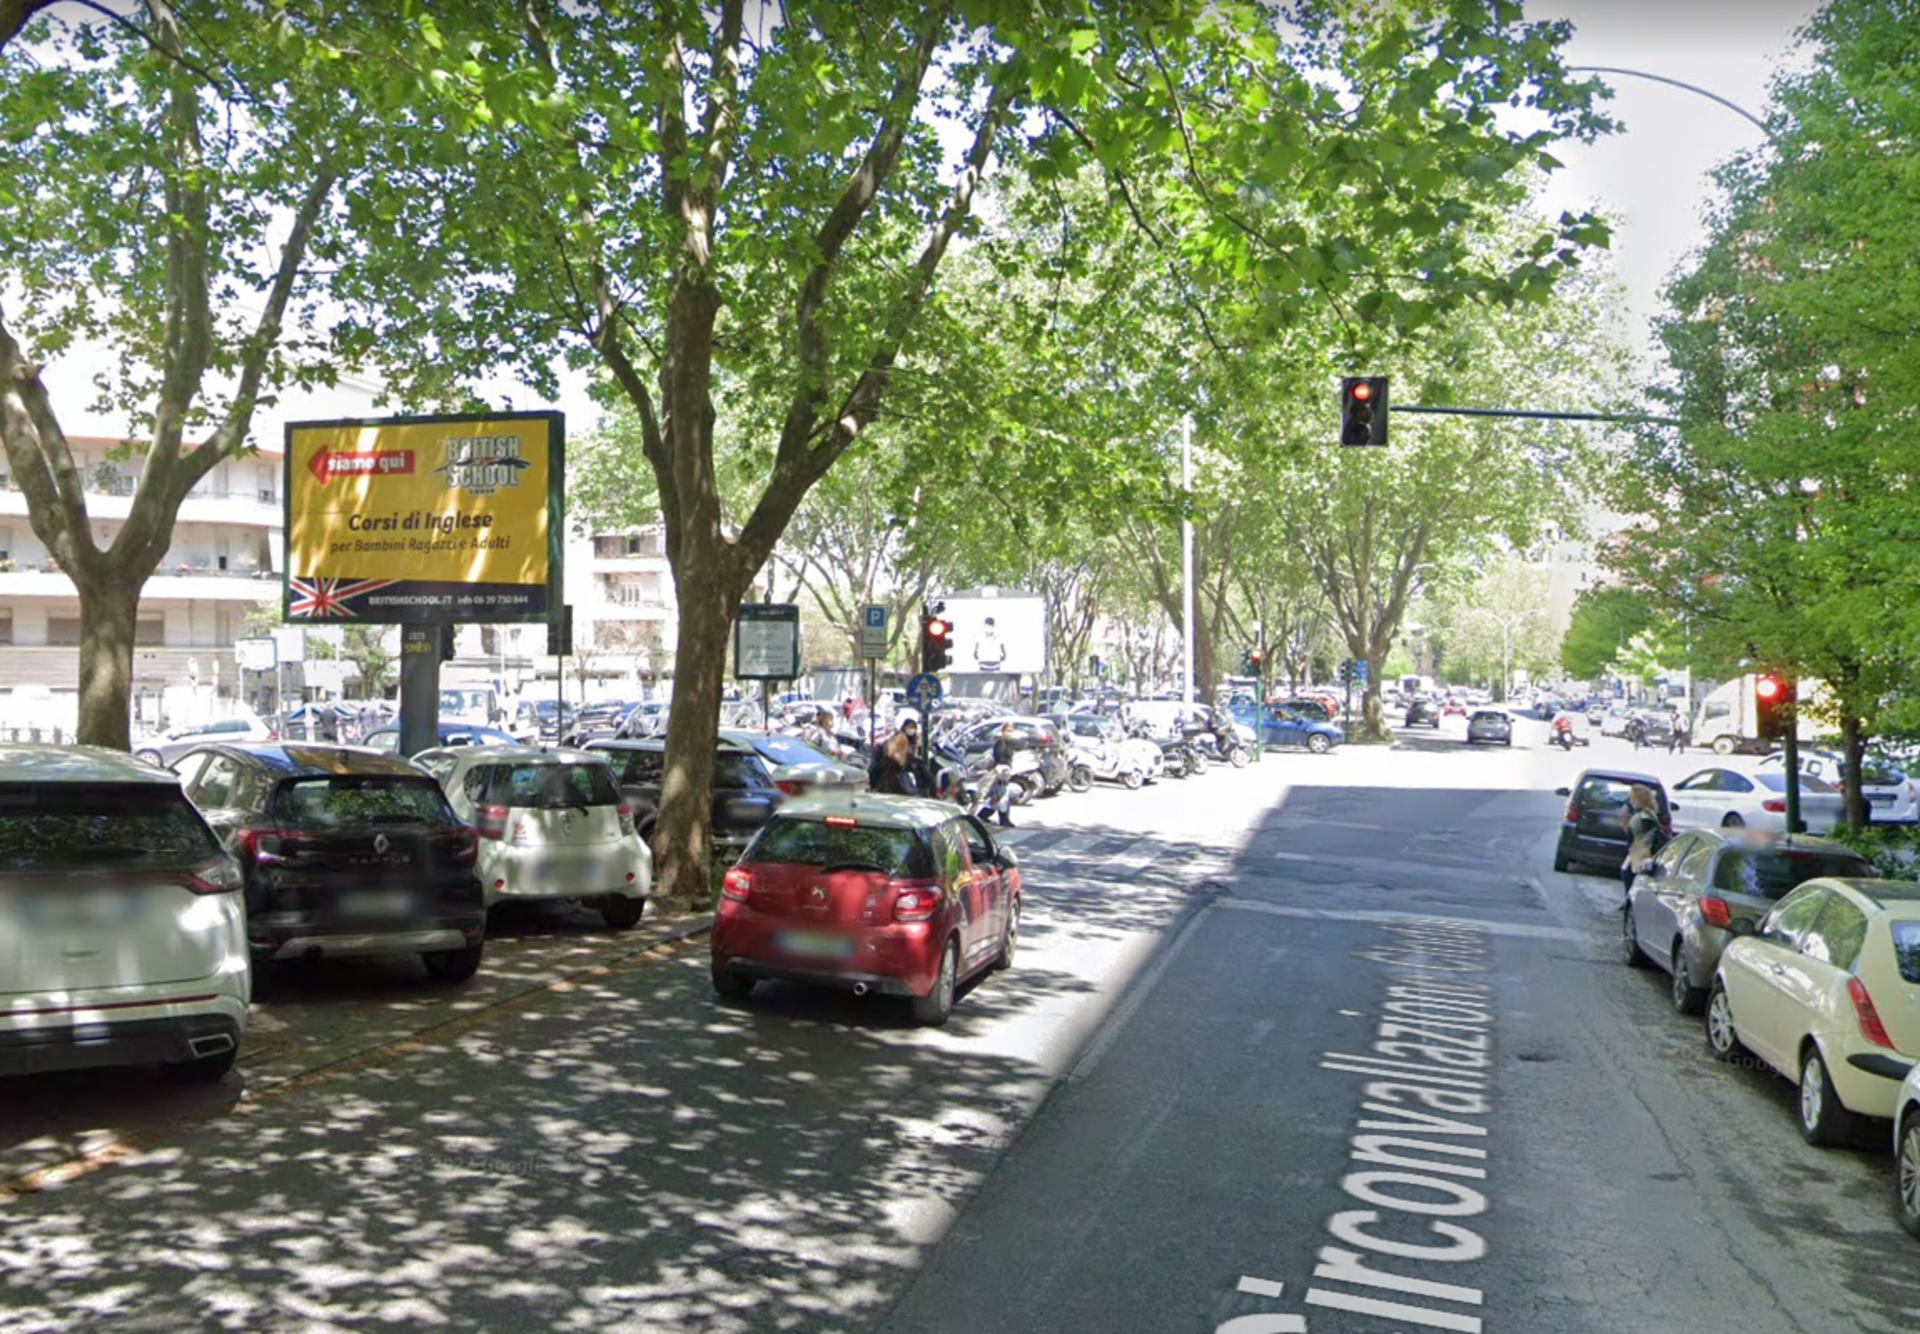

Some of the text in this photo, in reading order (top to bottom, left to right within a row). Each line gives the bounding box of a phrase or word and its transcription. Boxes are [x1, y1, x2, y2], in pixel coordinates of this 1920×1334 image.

[447, 436, 519, 459] BRITISH
[328, 452, 404, 473] siamo qui
[447, 465, 520, 487] SCHOOL
[349, 510, 493, 534] Corsi di Inglese
[331, 536, 510, 555] per Bambini Ragazzi e Adulti
